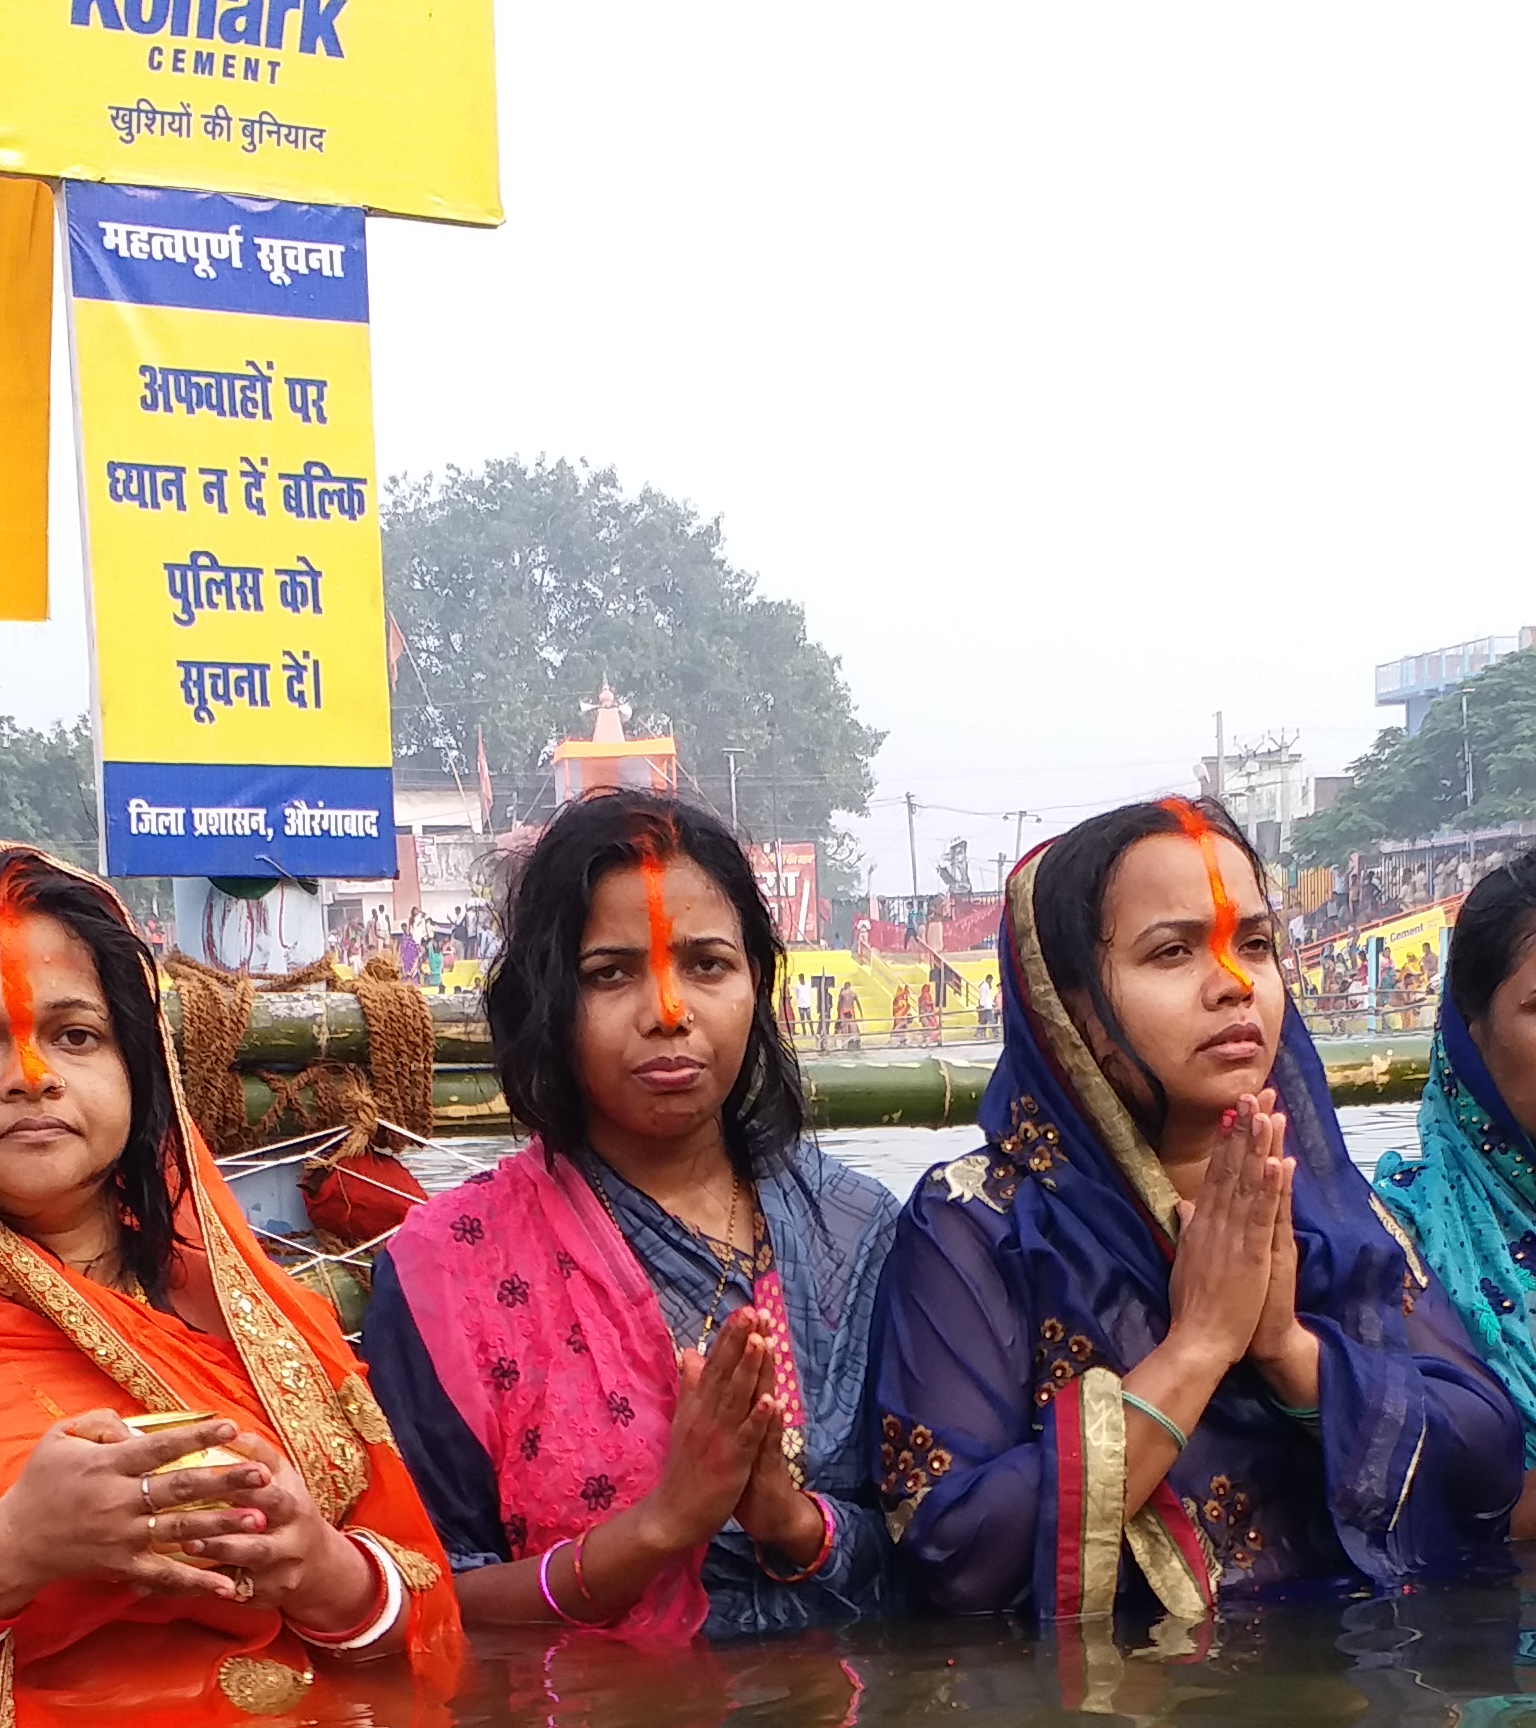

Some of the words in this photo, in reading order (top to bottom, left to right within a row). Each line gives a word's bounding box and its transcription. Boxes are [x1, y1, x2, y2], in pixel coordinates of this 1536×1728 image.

[148, 46, 282, 84] CEMENT
[108, 98, 192, 144] खुशियों
[201, 105, 232, 142] की
[239, 111, 327, 153] बुनियाद
[98, 221, 243, 280] महत्वपूर्ण
[254, 236, 345, 286] सूचना
[139, 360, 274, 420] अफवाहों
[284, 377, 327, 424] पर
[107, 461, 186, 511] ध्यान
[199, 468, 228, 514] न
[239, 457, 268, 516] दें
[278, 461, 367, 521] बल्कि
[163, 551, 263, 626] पुलिस
[275, 556, 322, 614] को
[177, 660, 270, 723] सूचना
[282, 650, 321, 709] दें।
[128, 799, 186, 836] जिला
[191, 807, 273, 841] प्रशासन,
[284, 800, 380, 837] औरंगाबाद
